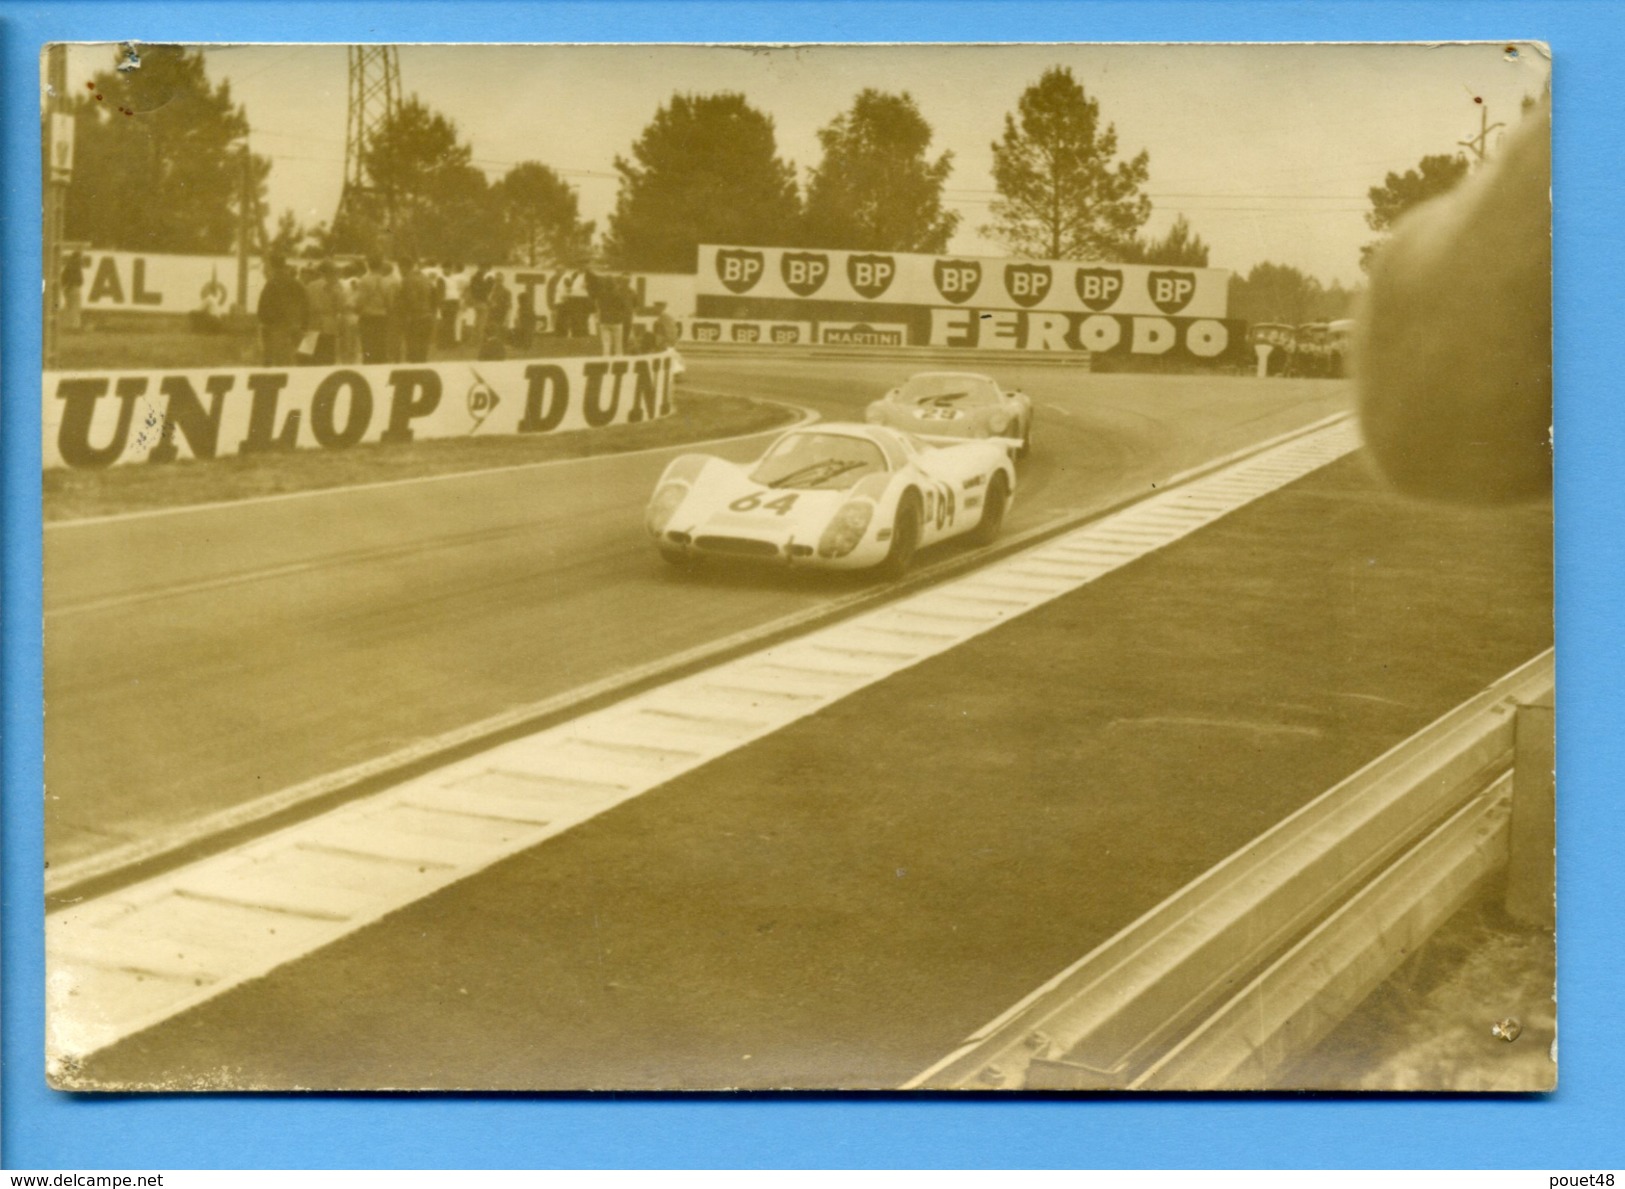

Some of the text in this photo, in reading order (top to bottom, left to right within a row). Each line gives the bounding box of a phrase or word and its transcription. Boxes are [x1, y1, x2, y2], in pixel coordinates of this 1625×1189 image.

[724, 257, 1192, 303] BP BP BP BP BP BP BP
[827, 332, 898, 345] MARTINI
[929, 308, 1228, 357] FERODO
[56, 368, 442, 469] UNLOP
[728, 491, 800, 516] 64
